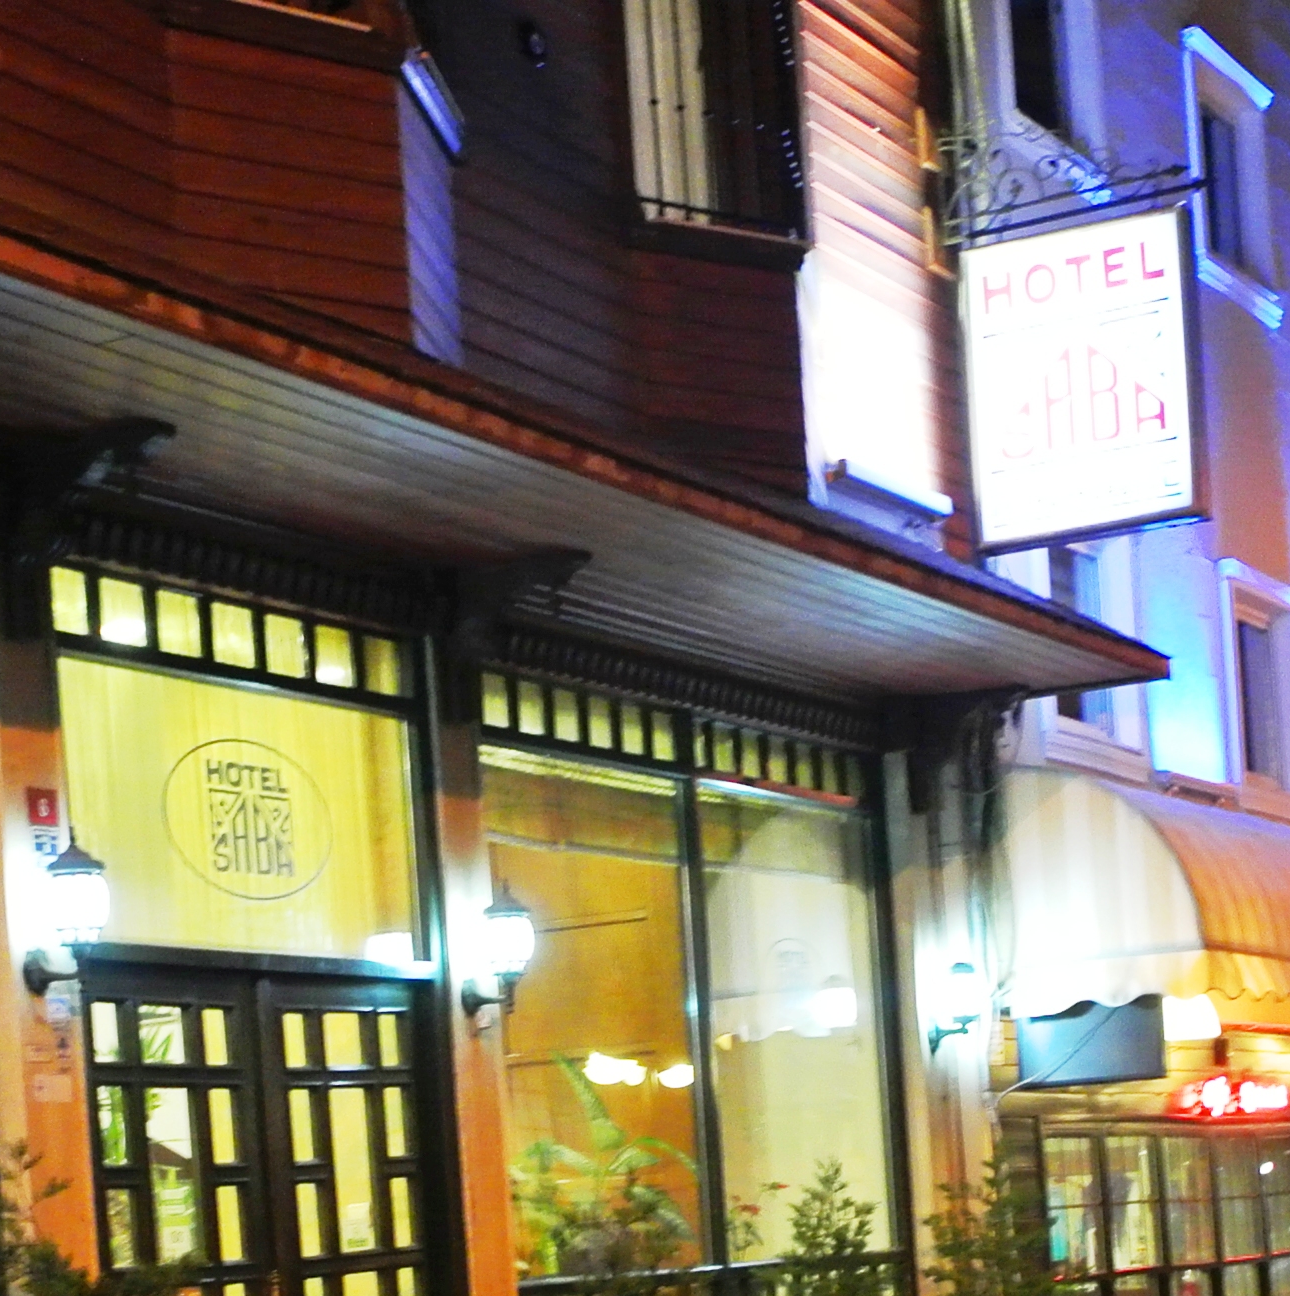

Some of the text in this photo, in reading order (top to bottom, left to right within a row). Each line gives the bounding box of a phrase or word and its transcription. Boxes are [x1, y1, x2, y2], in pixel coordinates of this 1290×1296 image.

[982, 242, 1165, 315] HOTEL
[206, 758, 289, 794] HOTEL
[213, 799, 295, 877] SABA
